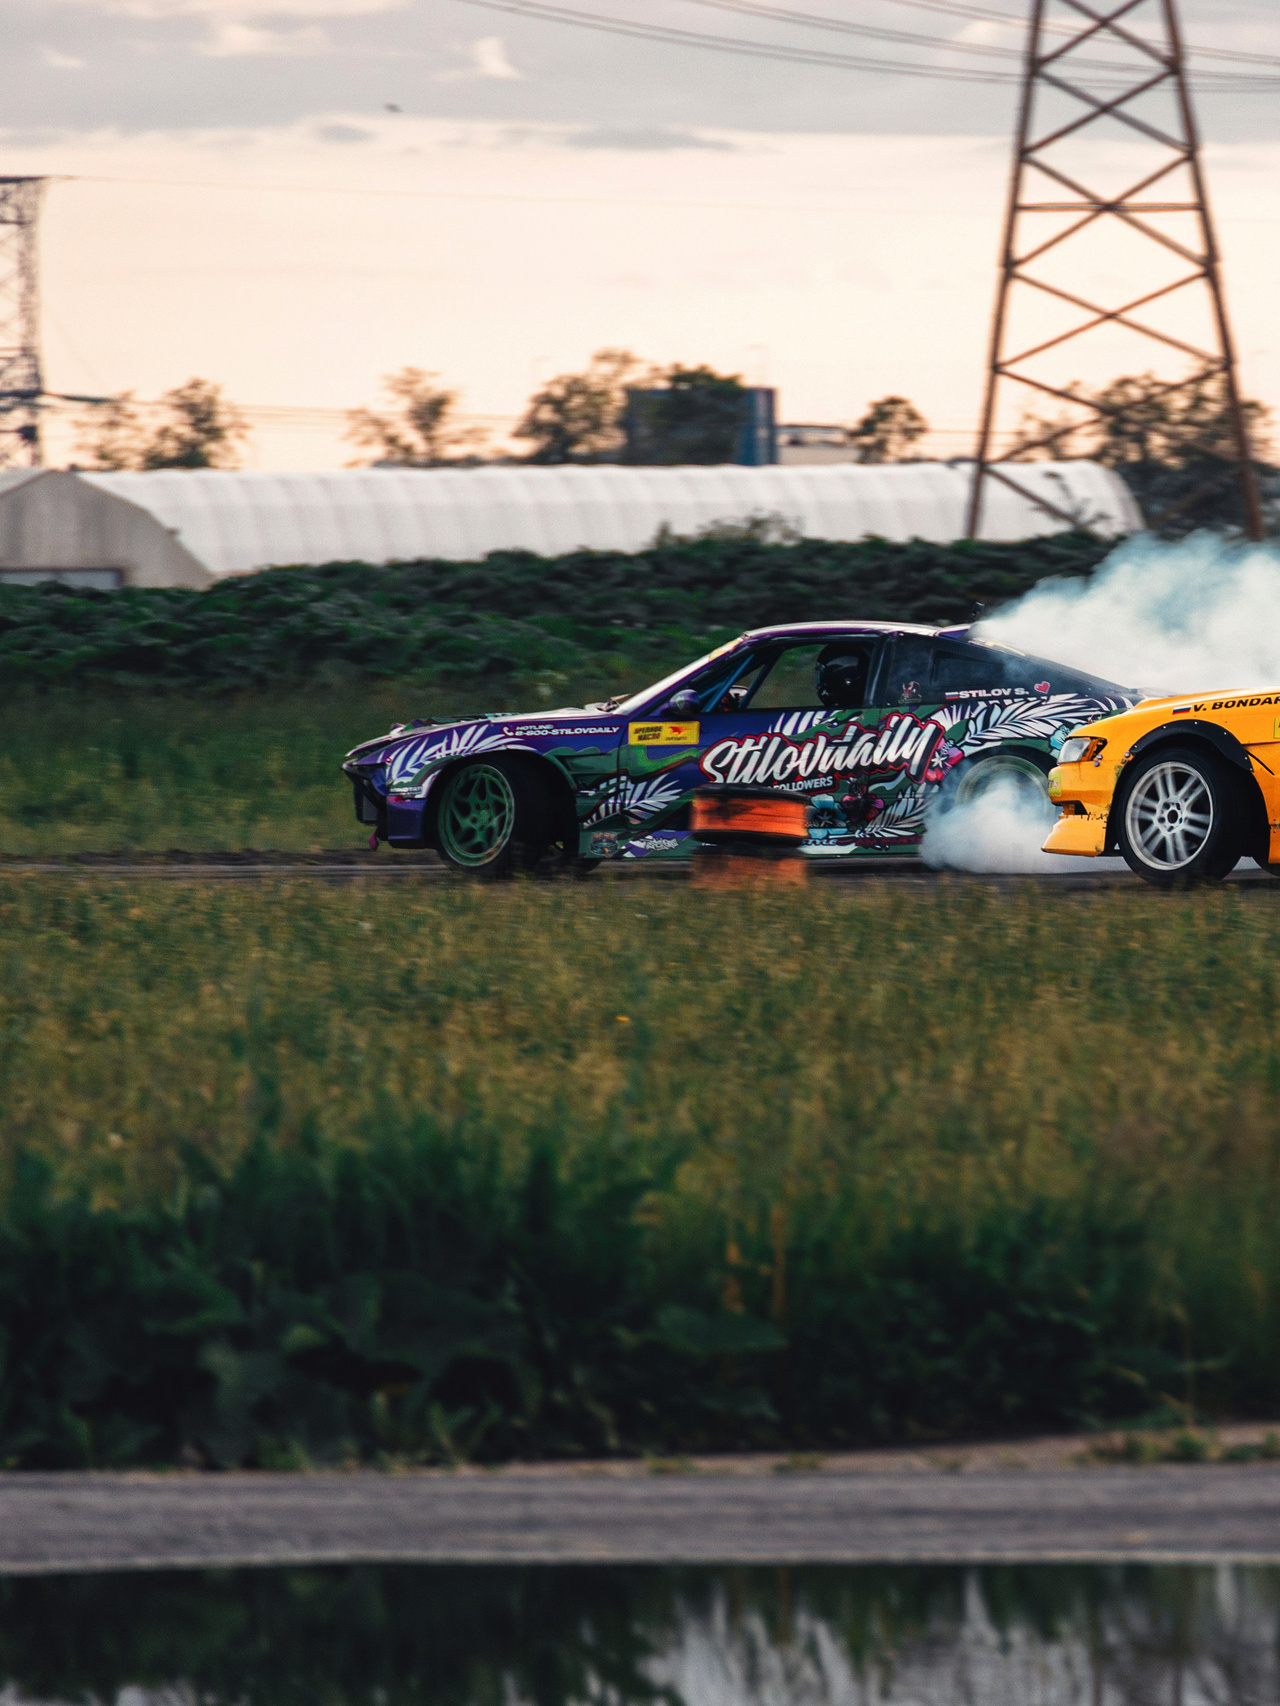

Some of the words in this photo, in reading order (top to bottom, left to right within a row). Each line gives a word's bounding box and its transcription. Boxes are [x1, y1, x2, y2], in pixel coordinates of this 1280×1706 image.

[959, 688, 1012, 698] STILOV
[1014, 687, 1029, 695] S.
[1193, 704, 1207, 712] V.
[515, 726, 620, 736] 8-800-STILOVDAILY
